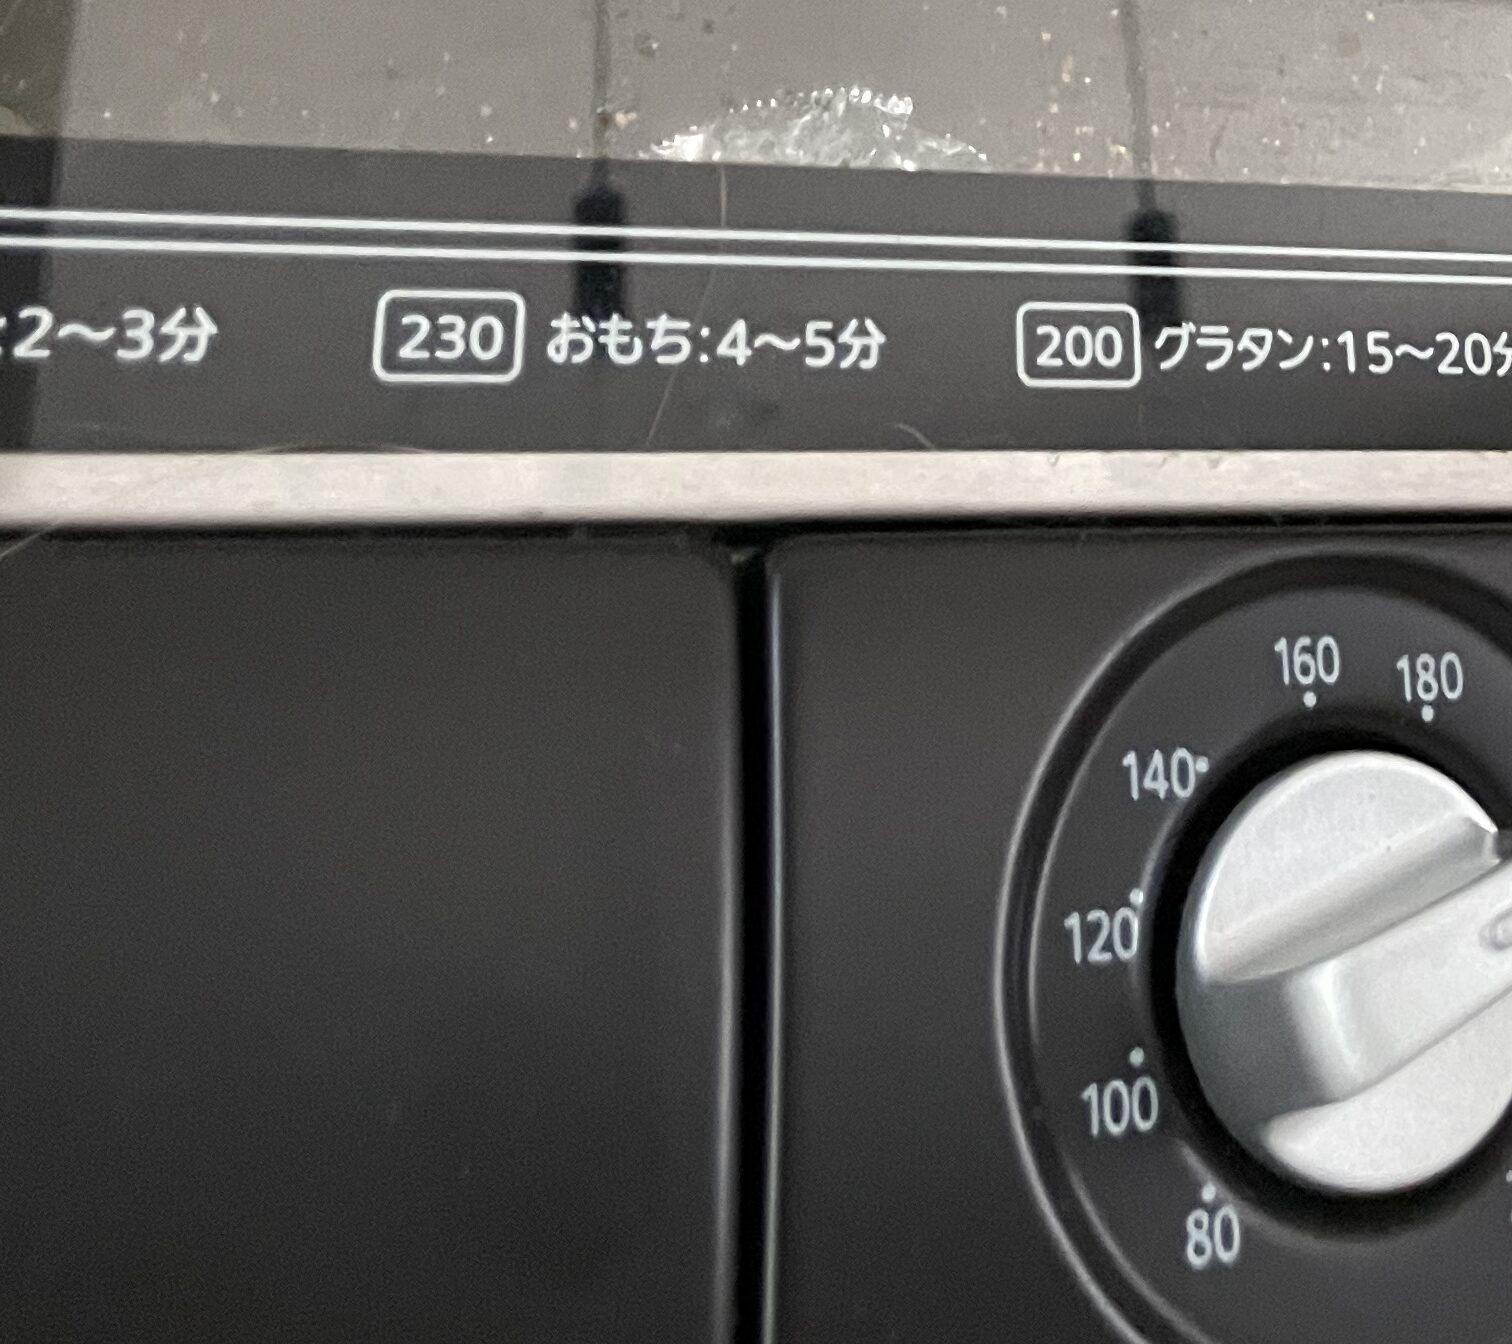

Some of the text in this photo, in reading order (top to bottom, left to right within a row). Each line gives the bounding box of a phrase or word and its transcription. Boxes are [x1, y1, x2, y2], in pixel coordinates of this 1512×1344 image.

[399, 313, 506, 361] 230
[1035, 324, 1124, 370] 200
[1273, 635, 1341, 686] 160
[1396, 652, 1464, 701] 180
[1122, 748, 1195, 800] 140
[1064, 908, 1138, 963] 120
[1081, 1075, 1158, 1136] 100
[1185, 1209, 1241, 1270] 80
